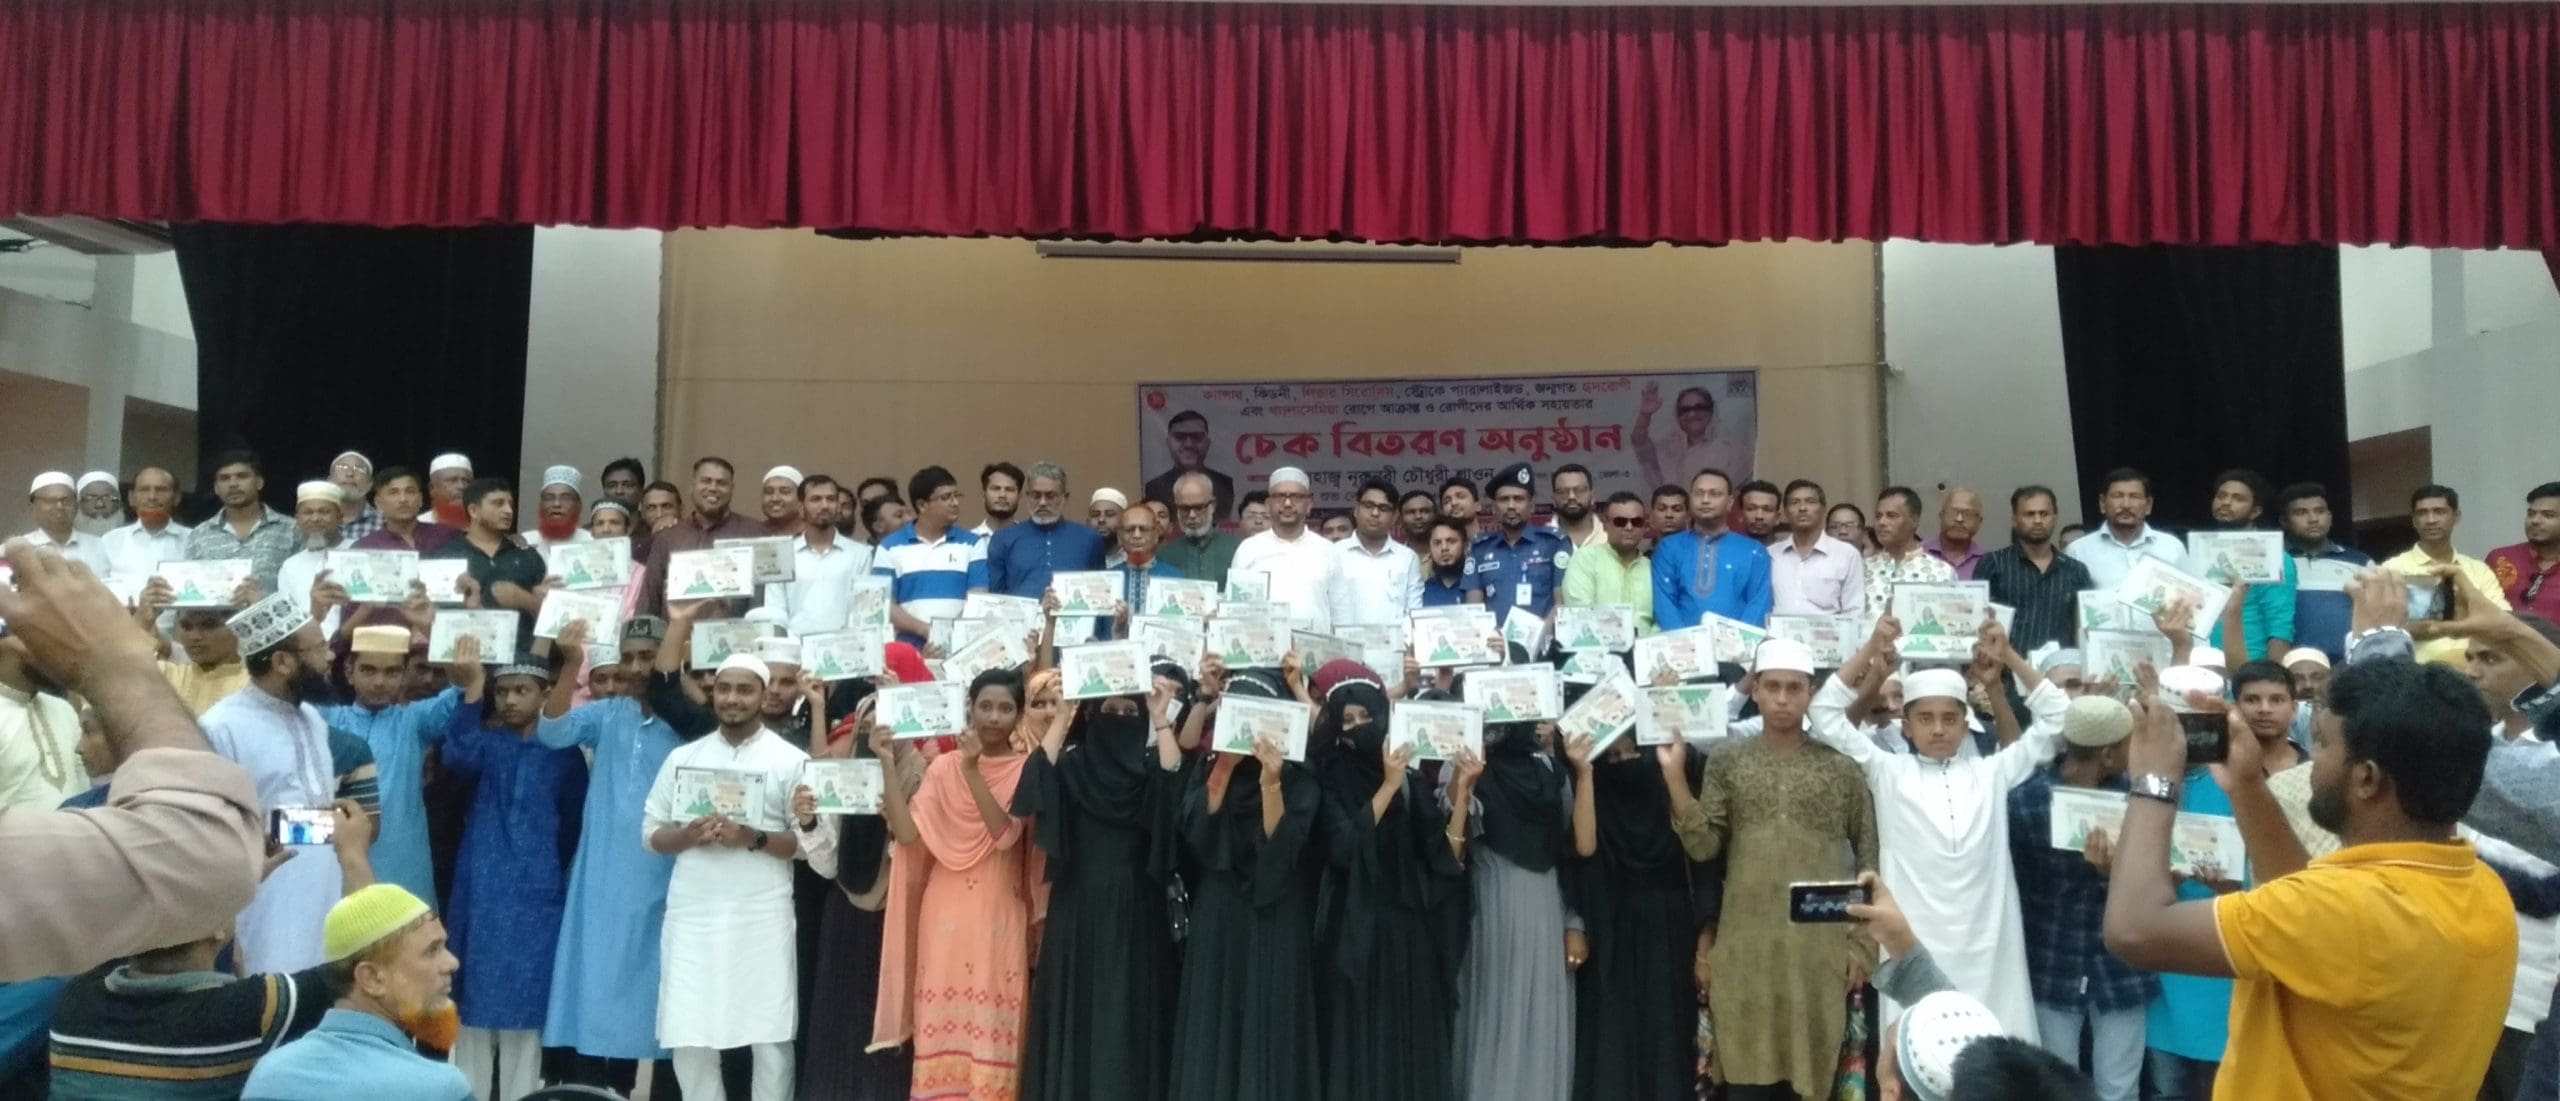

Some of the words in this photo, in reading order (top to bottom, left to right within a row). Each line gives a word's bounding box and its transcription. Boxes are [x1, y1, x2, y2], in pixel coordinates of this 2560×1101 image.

[1343, 403, 1376, 416] রোগে
[1426, 404, 1434, 414] ও
[1440, 398, 1491, 413] রোগীদের
[1497, 396, 1536, 411] আর্থিক
[1235, 432, 1321, 464] চেক
[1331, 420, 1465, 457] বিতরণ
[1476, 416, 1624, 463] অনুষ্ঠান
[1403, 463, 1449, 484] চৌধুরী
